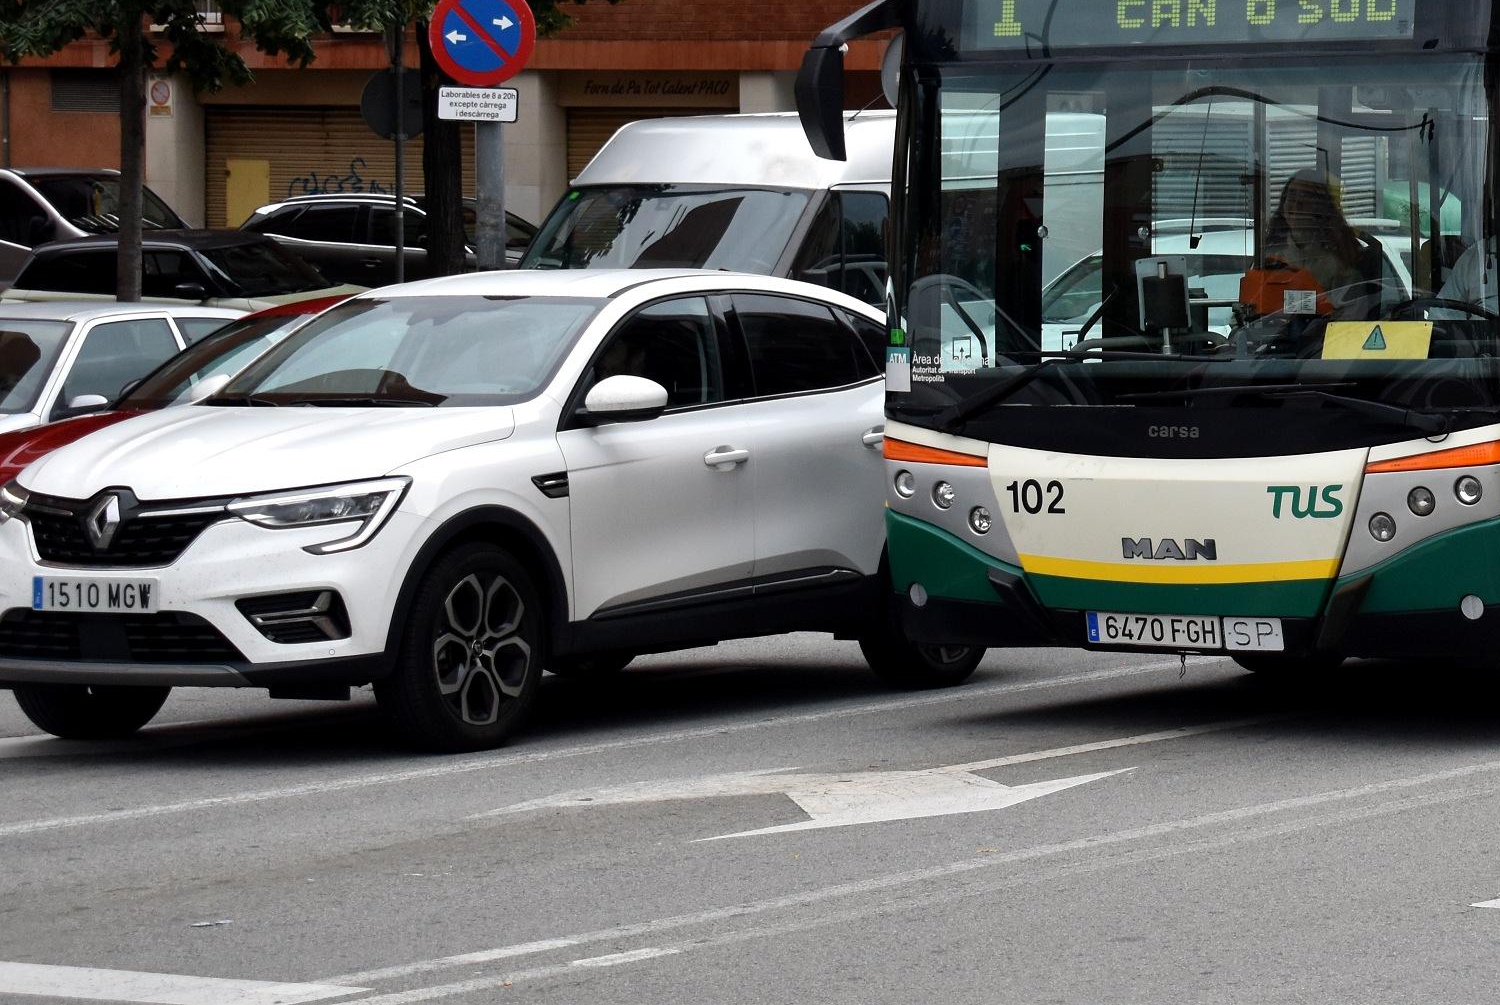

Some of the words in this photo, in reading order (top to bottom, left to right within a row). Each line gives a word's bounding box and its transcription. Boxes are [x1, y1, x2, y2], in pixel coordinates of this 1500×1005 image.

[611, 82, 625, 94] de
[627, 80, 641, 94] Pa
[643, 81, 660, 94] Tot
[698, 81, 730, 94] PACO
[441, 90, 480, 99] Laborables
[449, 100, 478, 109] excepte
[479, 101, 507, 110] càrrega
[459, 109, 499, 119] descàrrega
[889, 353, 907, 364] ATM
[912, 351, 931, 364] Àrea
[912, 375, 945, 383] Metropolità
[1006, 479, 1066, 515] 102
[1266, 484, 1344, 519] TUS
[1121, 537, 1217, 560] MAN
[49, 582, 100, 608] 1510
[108, 582, 151, 609] MGW
[1105, 615, 1165, 642] 6470
[1170, 618, 1217, 645] FGH
